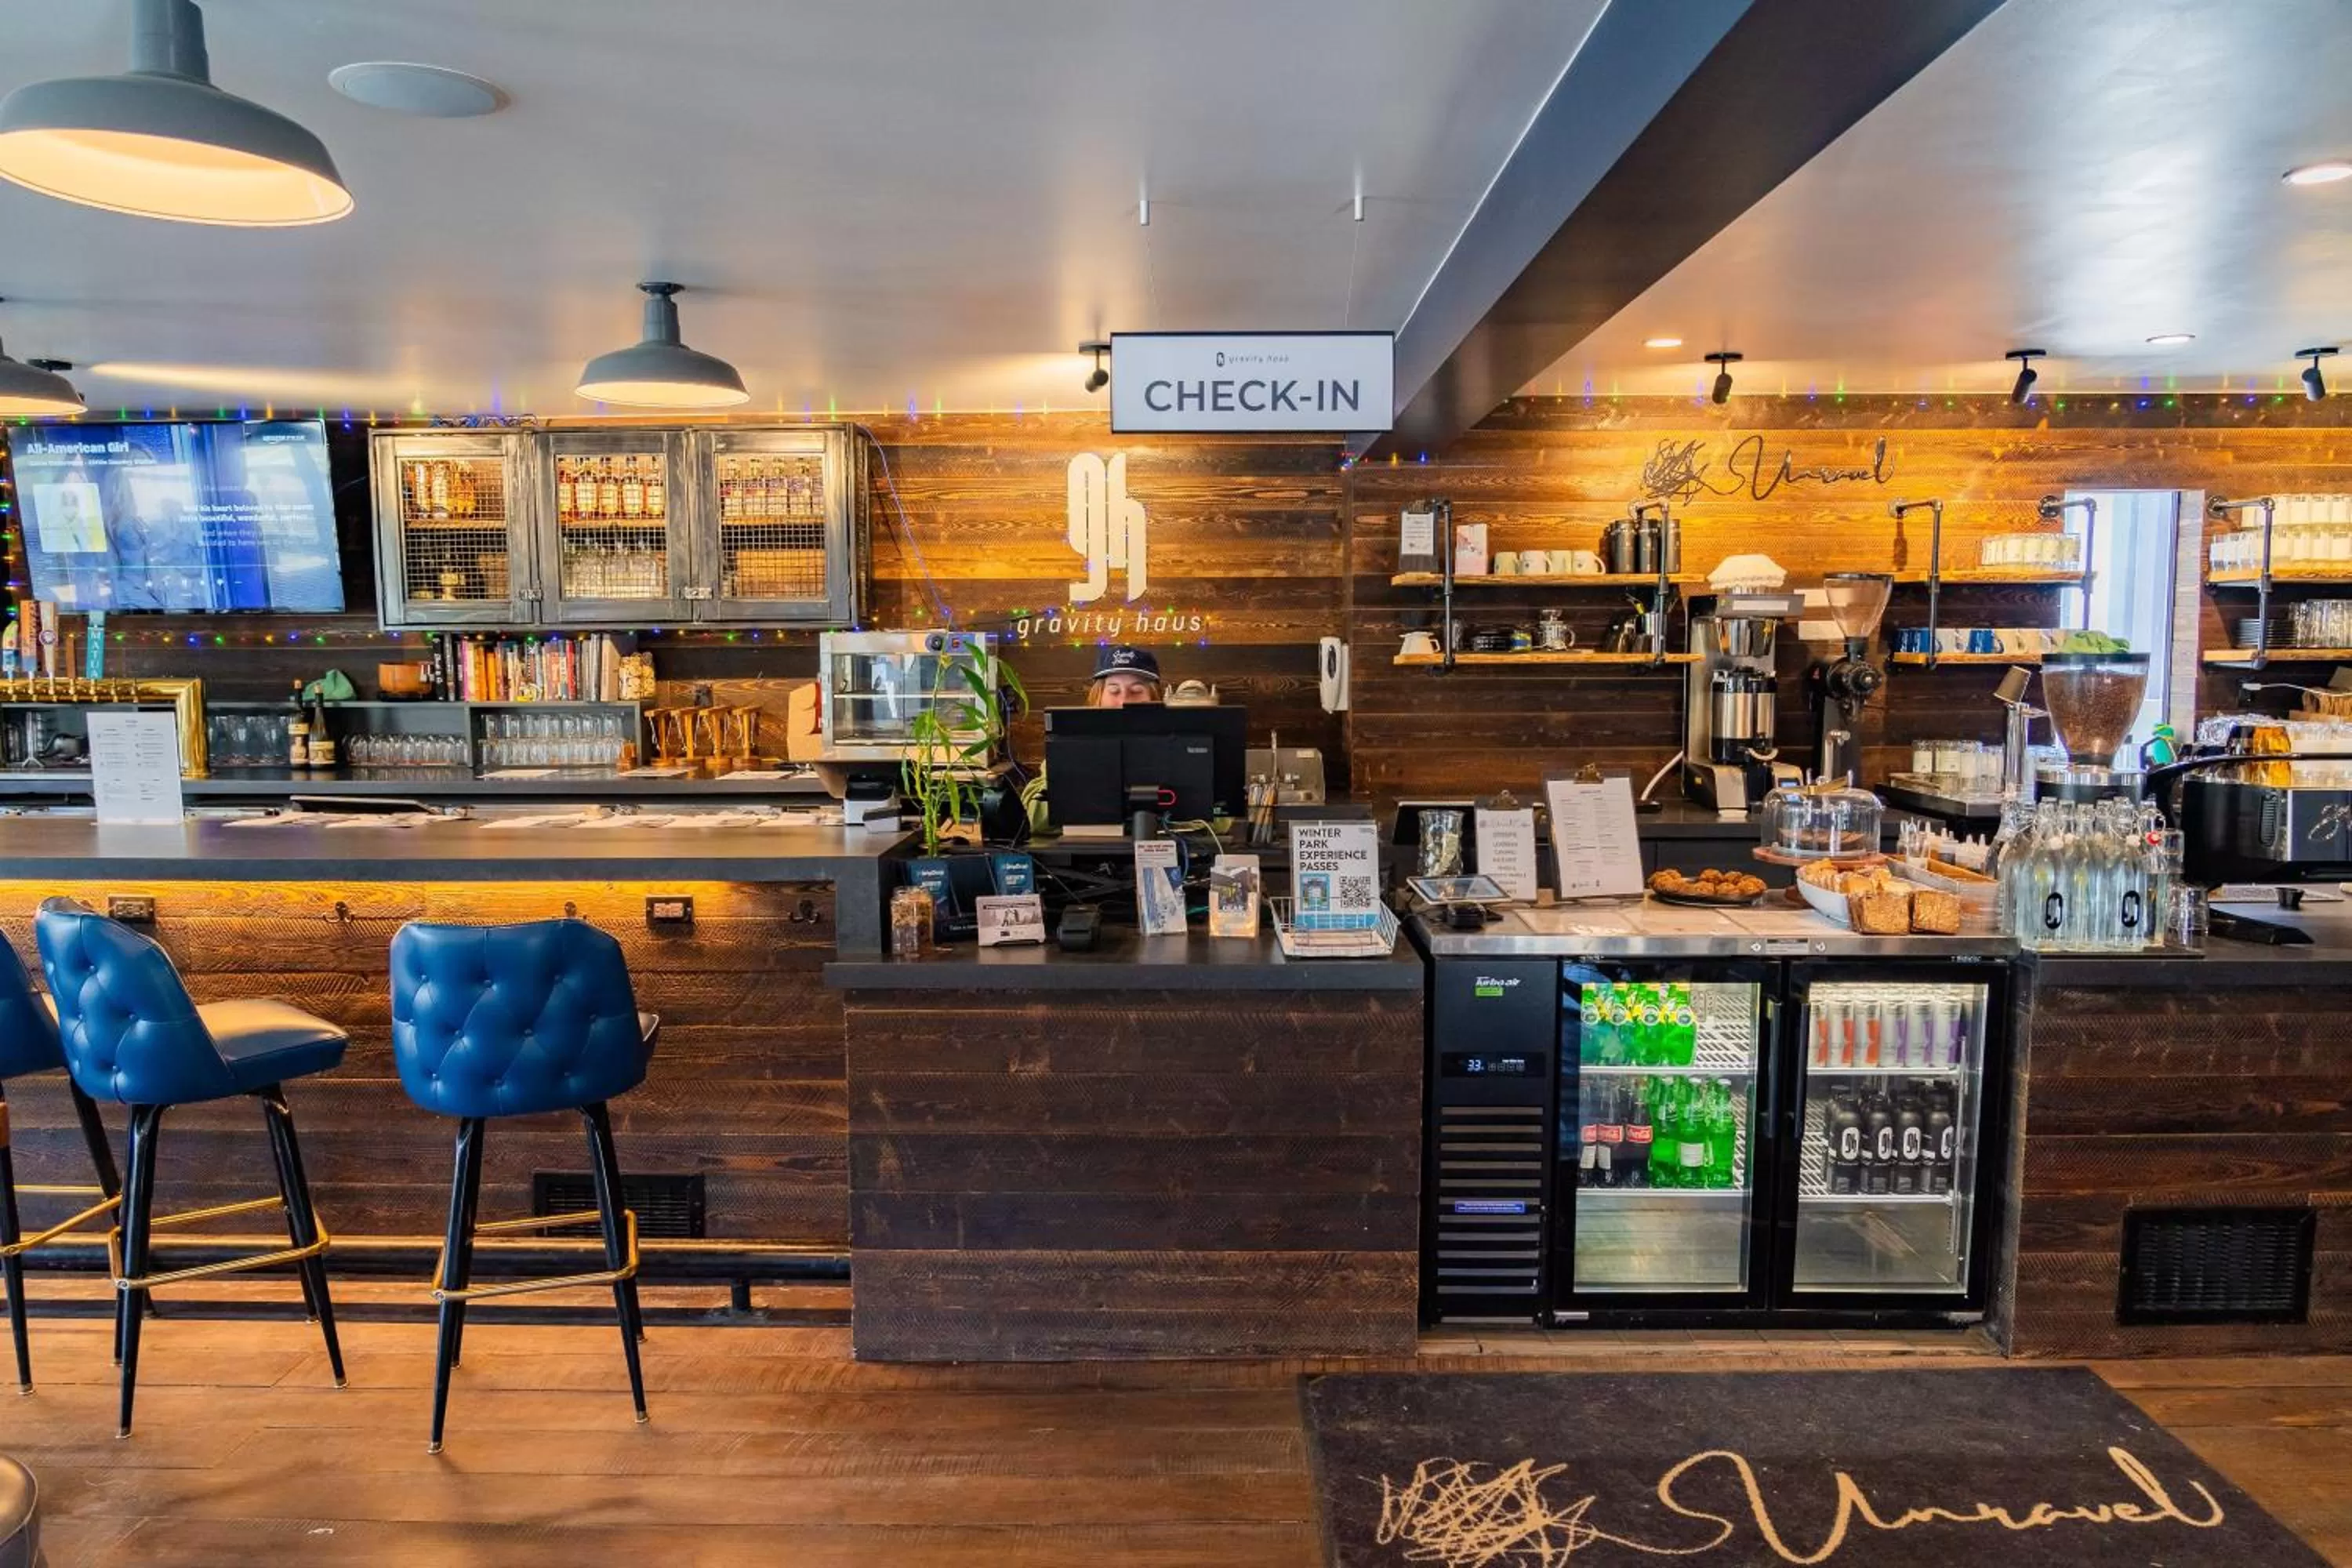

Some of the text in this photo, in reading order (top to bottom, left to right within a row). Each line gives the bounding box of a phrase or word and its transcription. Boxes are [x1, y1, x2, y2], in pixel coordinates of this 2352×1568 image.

[1144, 379, 1359, 412] CHECK-IN
[27, 441, 129, 455] All-American Girl
[1727, 434, 1896, 501] Unravel
[1017, 612, 1202, 639] gravity haus
[1298, 828, 1341, 838] WINTER
[1299, 840, 1329, 849] PARK
[1299, 850, 1367, 860] EXPERIENCE
[1299, 862, 1339, 871] PASSES
[1659, 1446, 2224, 1565] Unravel
